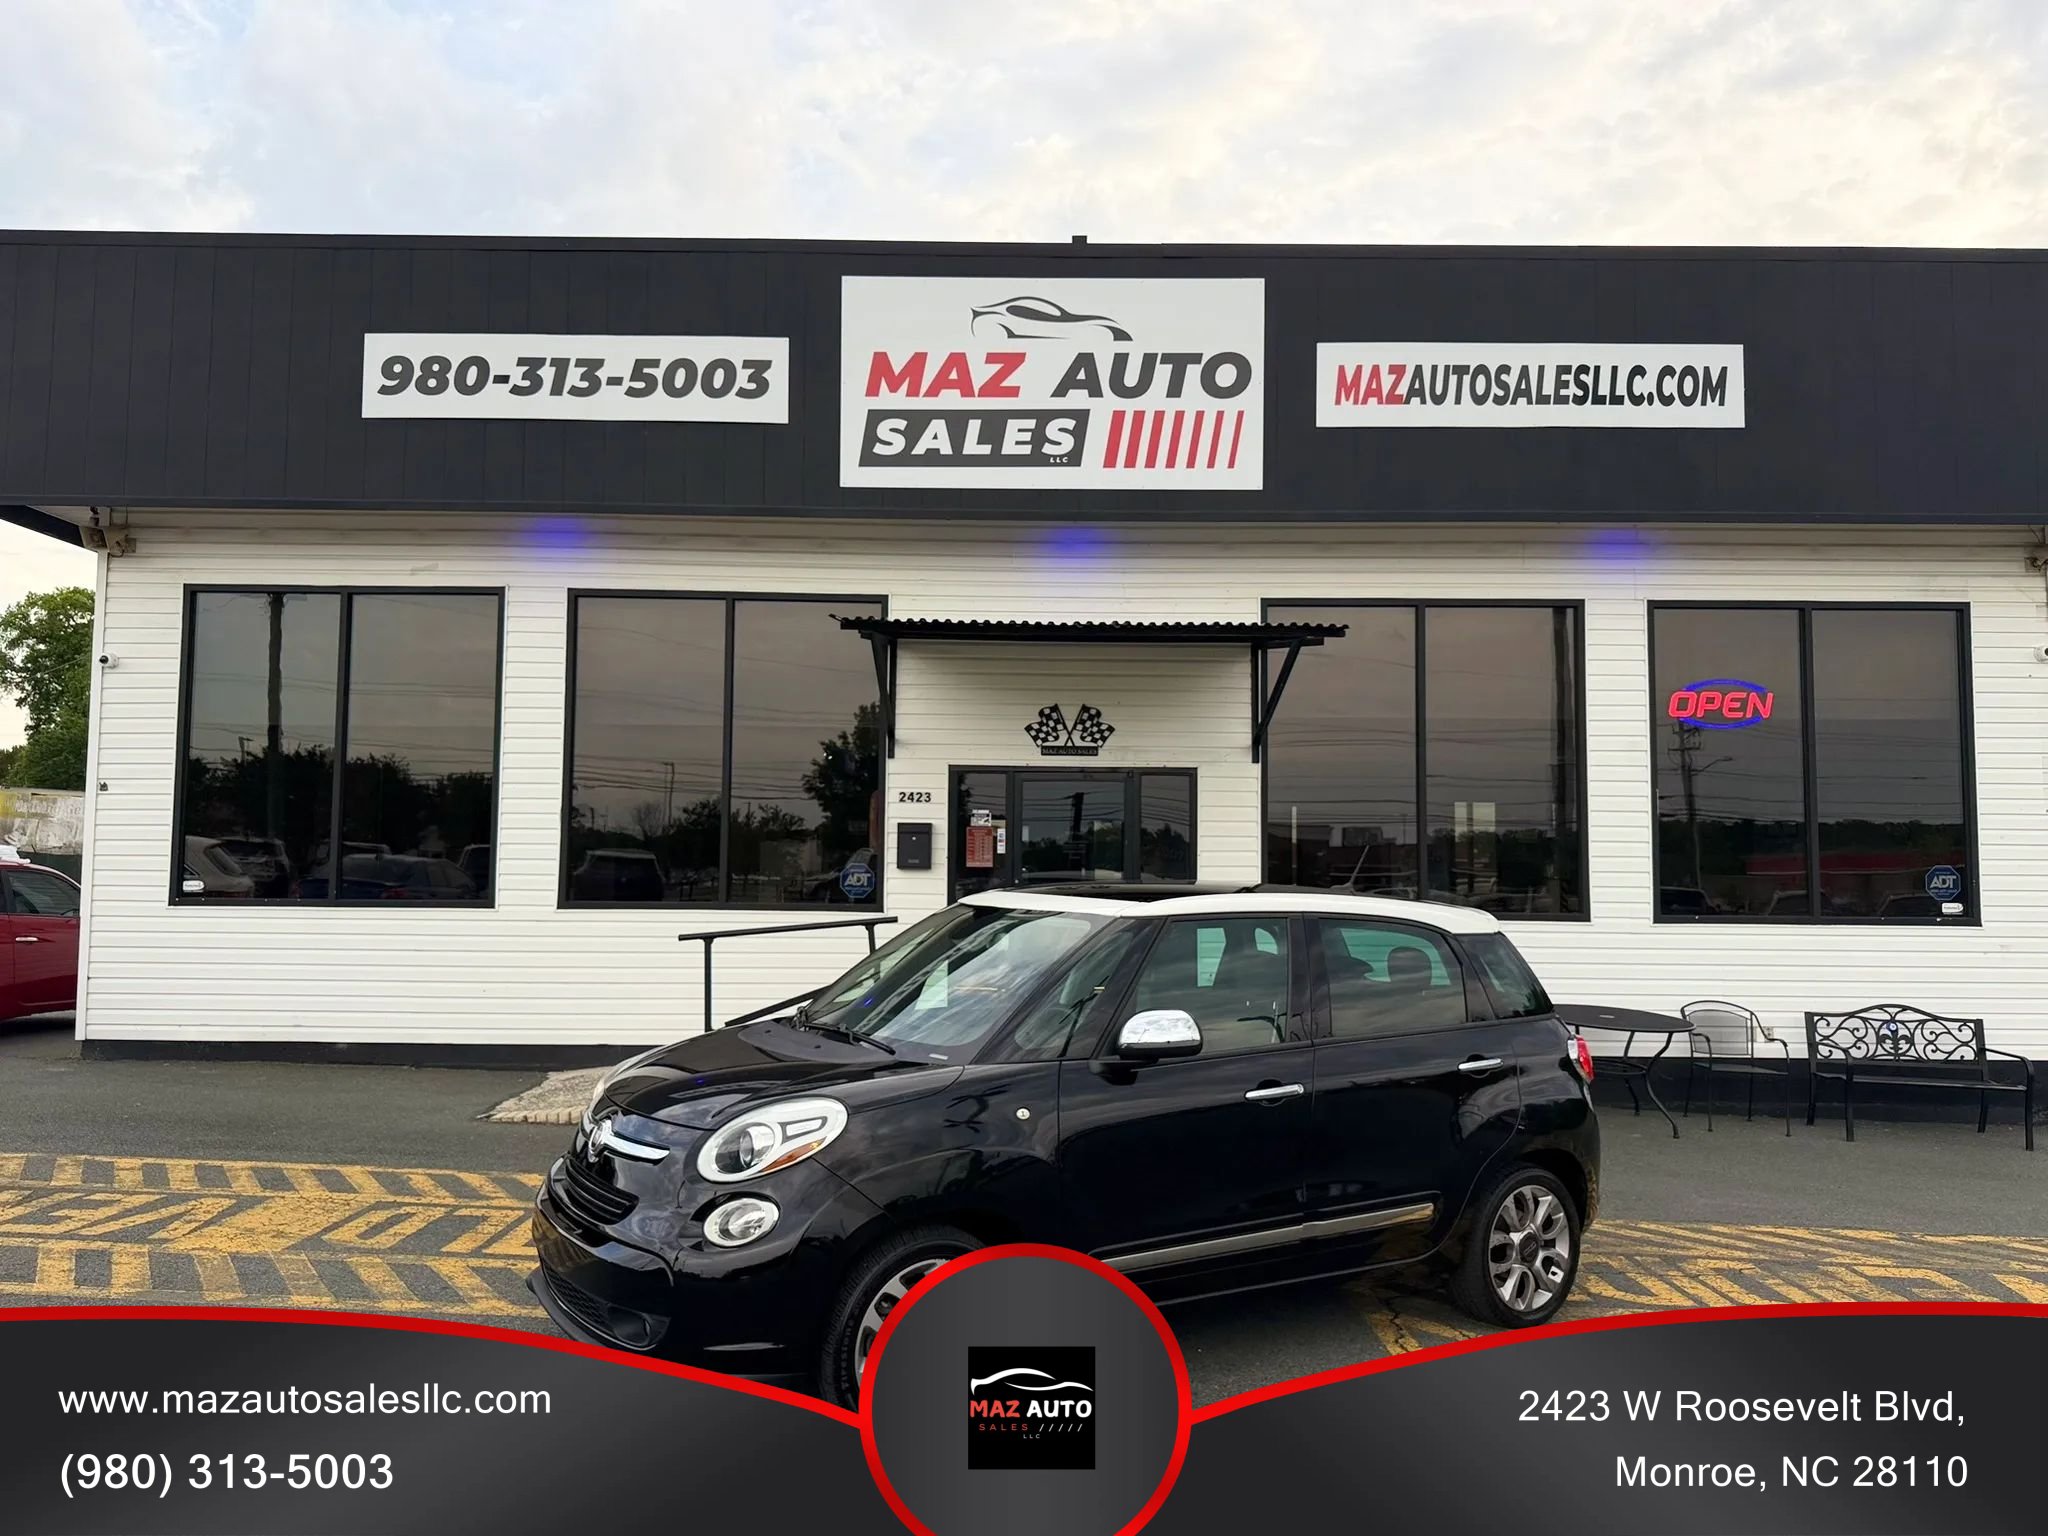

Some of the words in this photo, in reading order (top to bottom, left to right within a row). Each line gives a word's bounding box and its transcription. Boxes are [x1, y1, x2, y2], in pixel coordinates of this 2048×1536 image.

[377, 355, 773, 399] 980-313-5003
[864, 351, 1027, 398] MAZ
[1049, 352, 1252, 399] AUTO
[1334, 363, 1729, 407] MAZAUTOSALESLLC.COM
[872, 418, 1077, 456] SALES
[1668, 691, 1774, 718] OPEN
[898, 791, 932, 803] 2423
[844, 873, 871, 887] ADT
[1930, 875, 1957, 889] ADT
